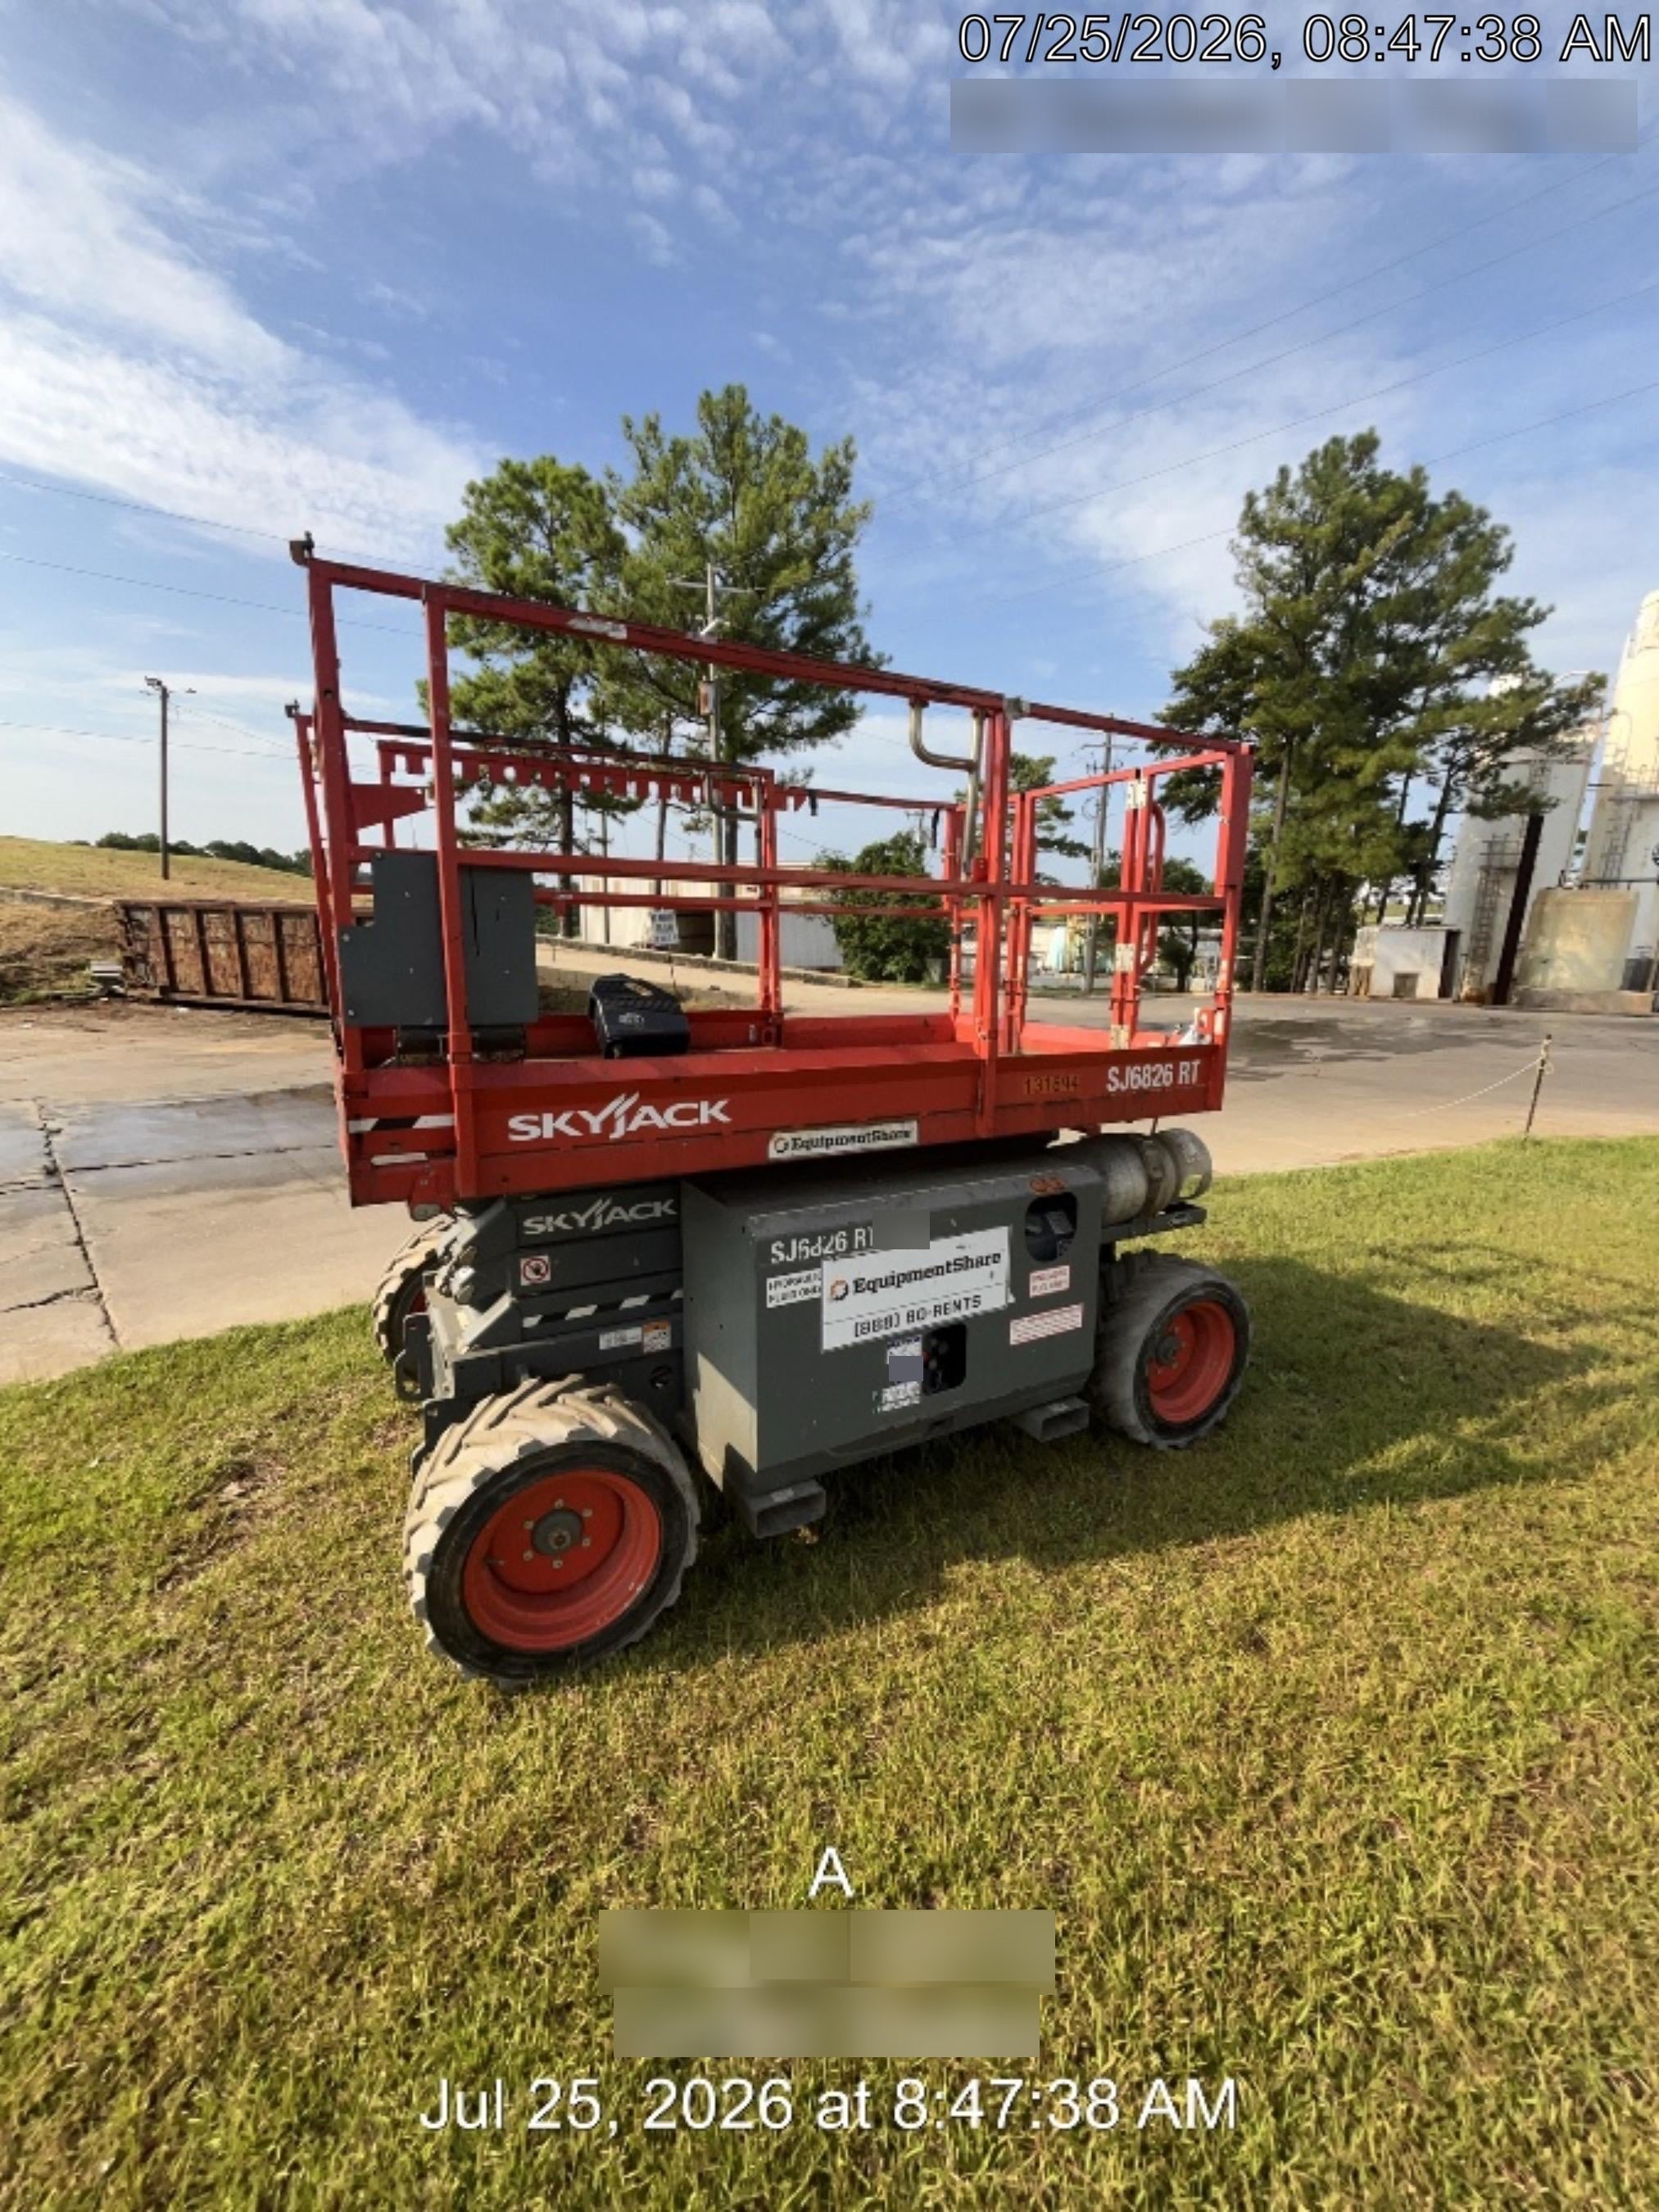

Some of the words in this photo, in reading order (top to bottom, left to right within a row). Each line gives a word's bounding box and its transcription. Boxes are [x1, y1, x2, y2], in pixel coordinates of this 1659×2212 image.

[1108, 1063, 1172, 1092] SJ6826
[1179, 1059, 1200, 1085] RT
[508, 1091, 732, 1141] SKYJACK
[791, 1130, 911, 1151] EquipmentShare
[523, 1196, 678, 1235] SKYJACK
[770, 1231, 848, 1264] SJ6826
[853, 1253, 1001, 1294] EquipmentShare
[854, 1312, 900, 1337] (888)
[907, 1295, 981, 1324] 80-RENTS
